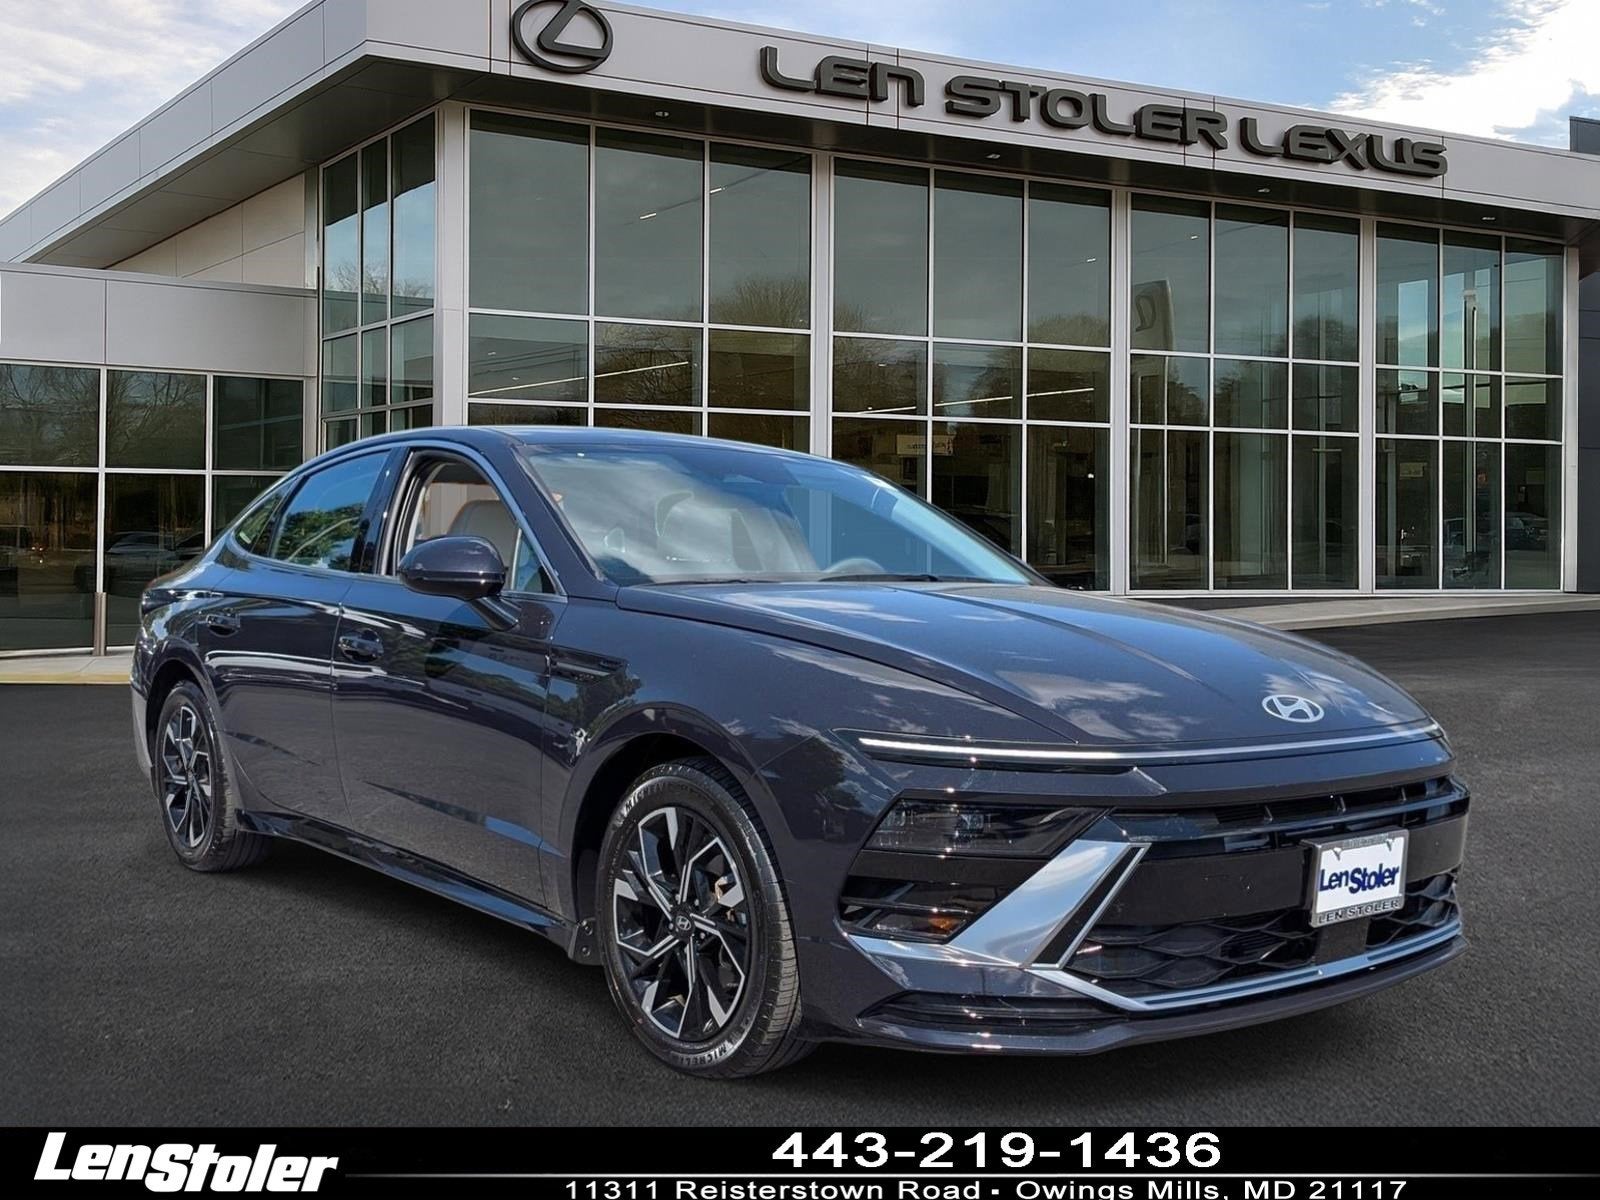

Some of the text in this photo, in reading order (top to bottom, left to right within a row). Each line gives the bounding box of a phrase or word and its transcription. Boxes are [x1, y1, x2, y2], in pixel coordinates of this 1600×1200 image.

[759, 45, 1449, 177] LEN STOLER LEXUS
[1318, 899, 1400, 924] LEN STOLER
